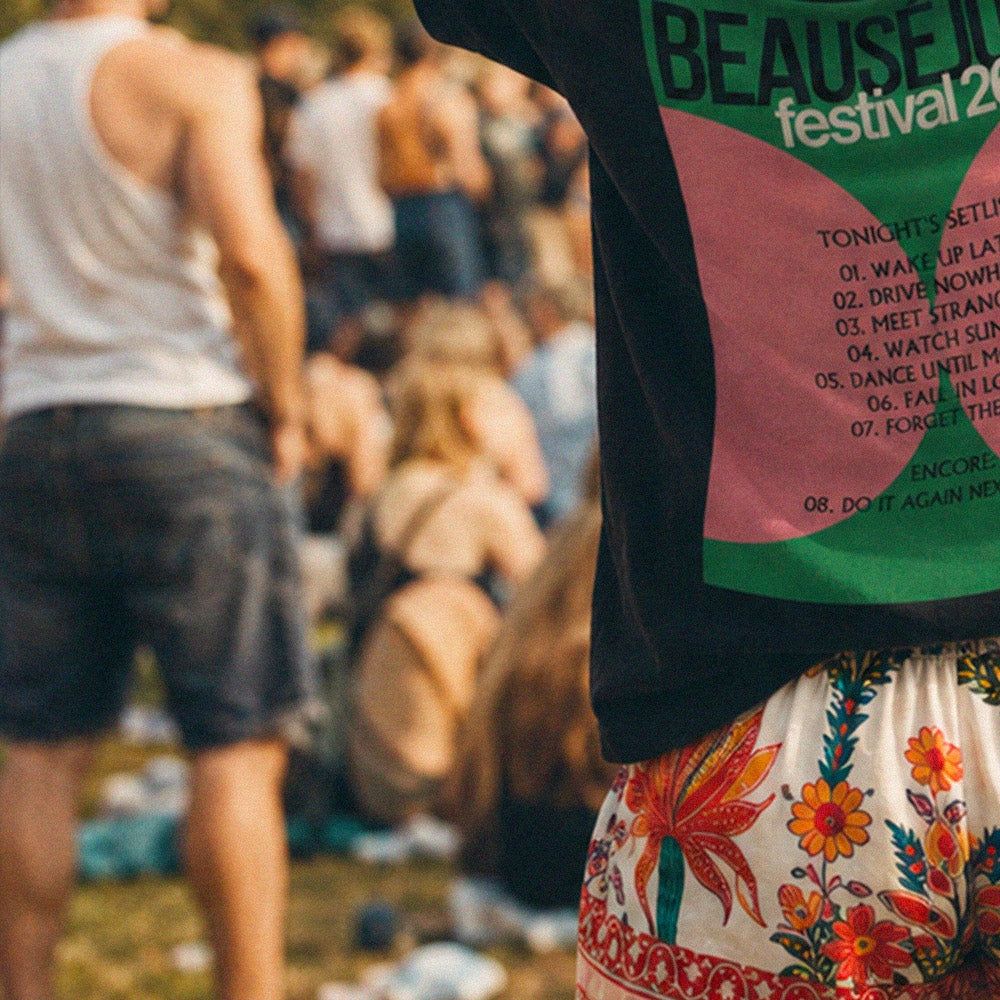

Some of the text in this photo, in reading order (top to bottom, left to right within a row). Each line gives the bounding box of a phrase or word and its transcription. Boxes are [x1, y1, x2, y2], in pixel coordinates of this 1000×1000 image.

[775, 72, 958, 149] festival
[817, 213, 941, 249] TONIGHT'S
[839, 264, 867, 283] 01.
[871, 252, 935, 278] WAKE
[938, 246, 965, 267] UP
[833, 291, 863, 310] 02.
[869, 281, 927, 307] DRIVE
[834, 318, 866, 337] 03.
[871, 309, 922, 334] MEET
[846, 345, 879, 363] 04.
[884, 328, 960, 360] WATCH
[815, 372, 844, 390] 05.
[850, 366, 918, 389] DANCE
[921, 356, 978, 380] UNTIL
[867, 395, 898, 412] 06.
[904, 388, 949, 409] FALL
[954, 380, 977, 399] IN
[851, 419, 879, 438] 07.
[885, 407, 961, 435] FORGET
[804, 496, 834, 514] 08.
[842, 495, 872, 513] DO
[876, 495, 895, 512] IT
[900, 484, 963, 510] AGAIN
